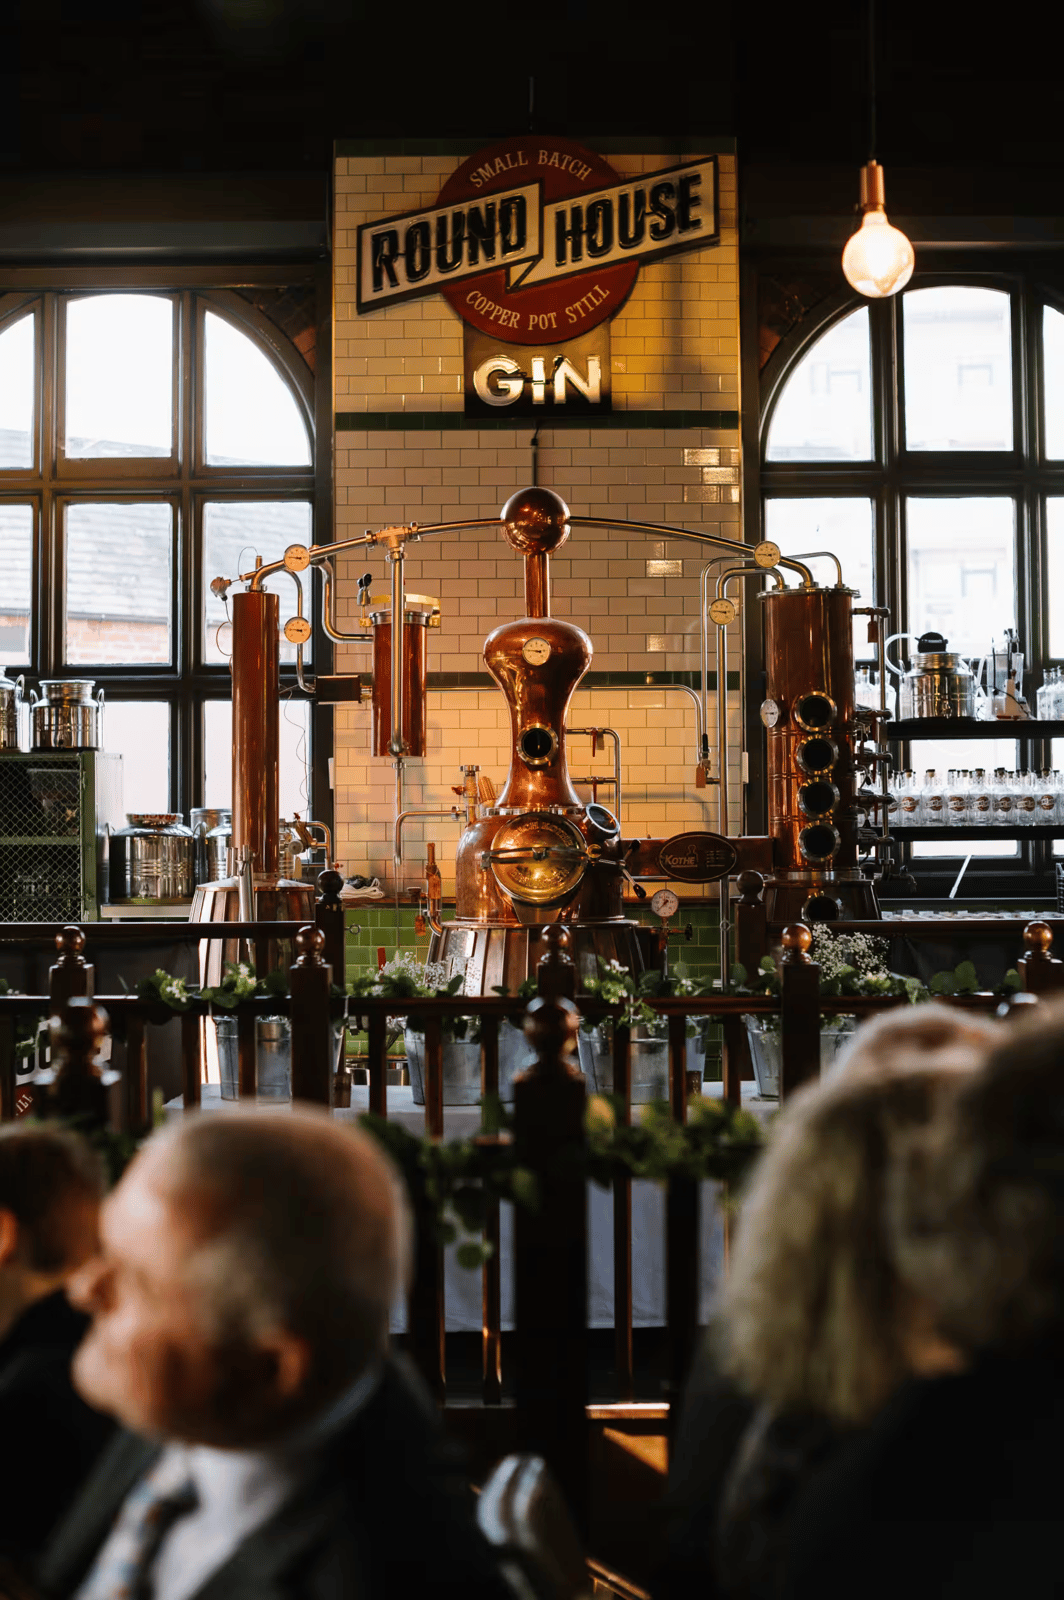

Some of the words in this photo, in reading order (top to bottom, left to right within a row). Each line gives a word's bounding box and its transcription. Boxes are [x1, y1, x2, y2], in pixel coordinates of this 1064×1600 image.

[469, 150, 529, 188] SMALL
[537, 149, 593, 182] BATCH
[370, 193, 528, 293] ROUND
[554, 173, 704, 268] HOUSE
[466, 290, 521, 329] COPPER
[528, 312, 558, 331] POT
[565, 284, 611, 324] STILL
[473, 354, 602, 407] GIN
